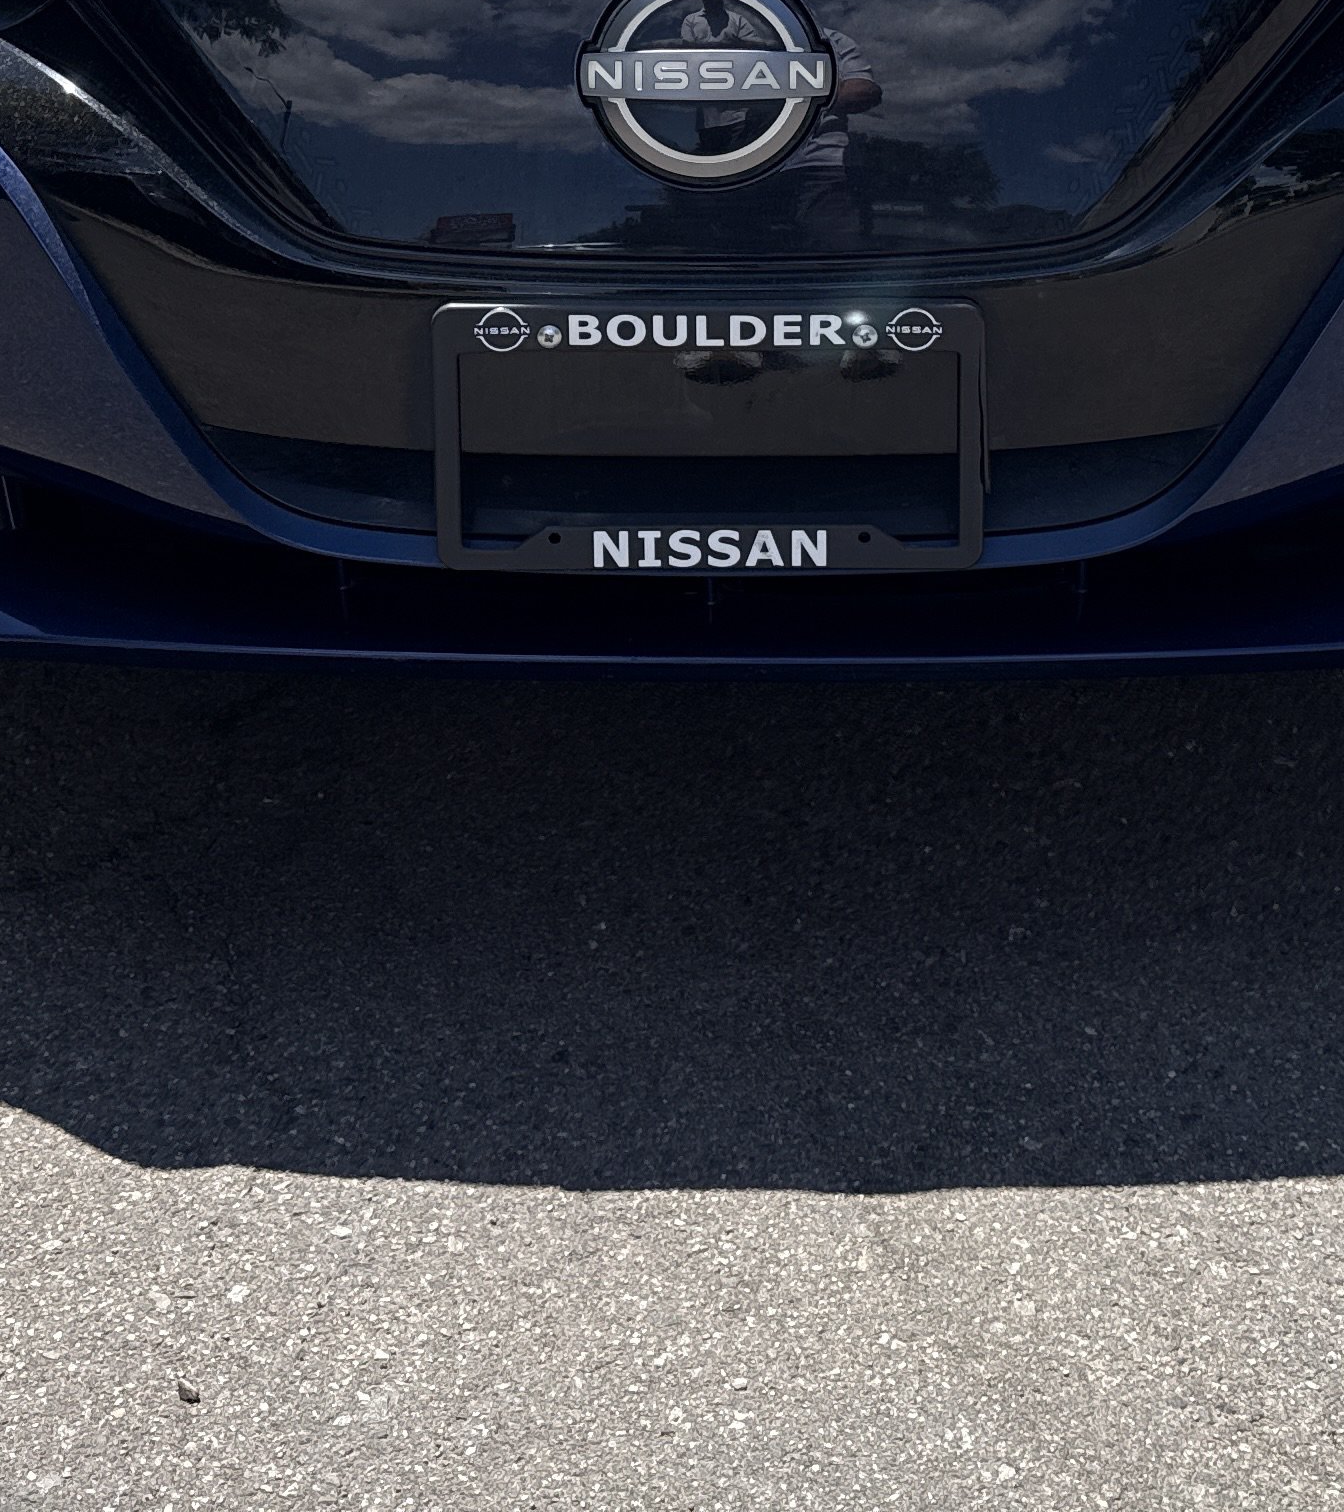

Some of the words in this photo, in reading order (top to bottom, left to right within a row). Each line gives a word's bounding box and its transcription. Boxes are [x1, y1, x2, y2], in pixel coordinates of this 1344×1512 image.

[587, 60, 824, 91] NISSAN
[473, 326, 531, 336] NISSAN
[568, 314, 846, 347] BOULDER
[885, 325, 943, 335] NISSAN
[593, 529, 827, 568] NISSAN
